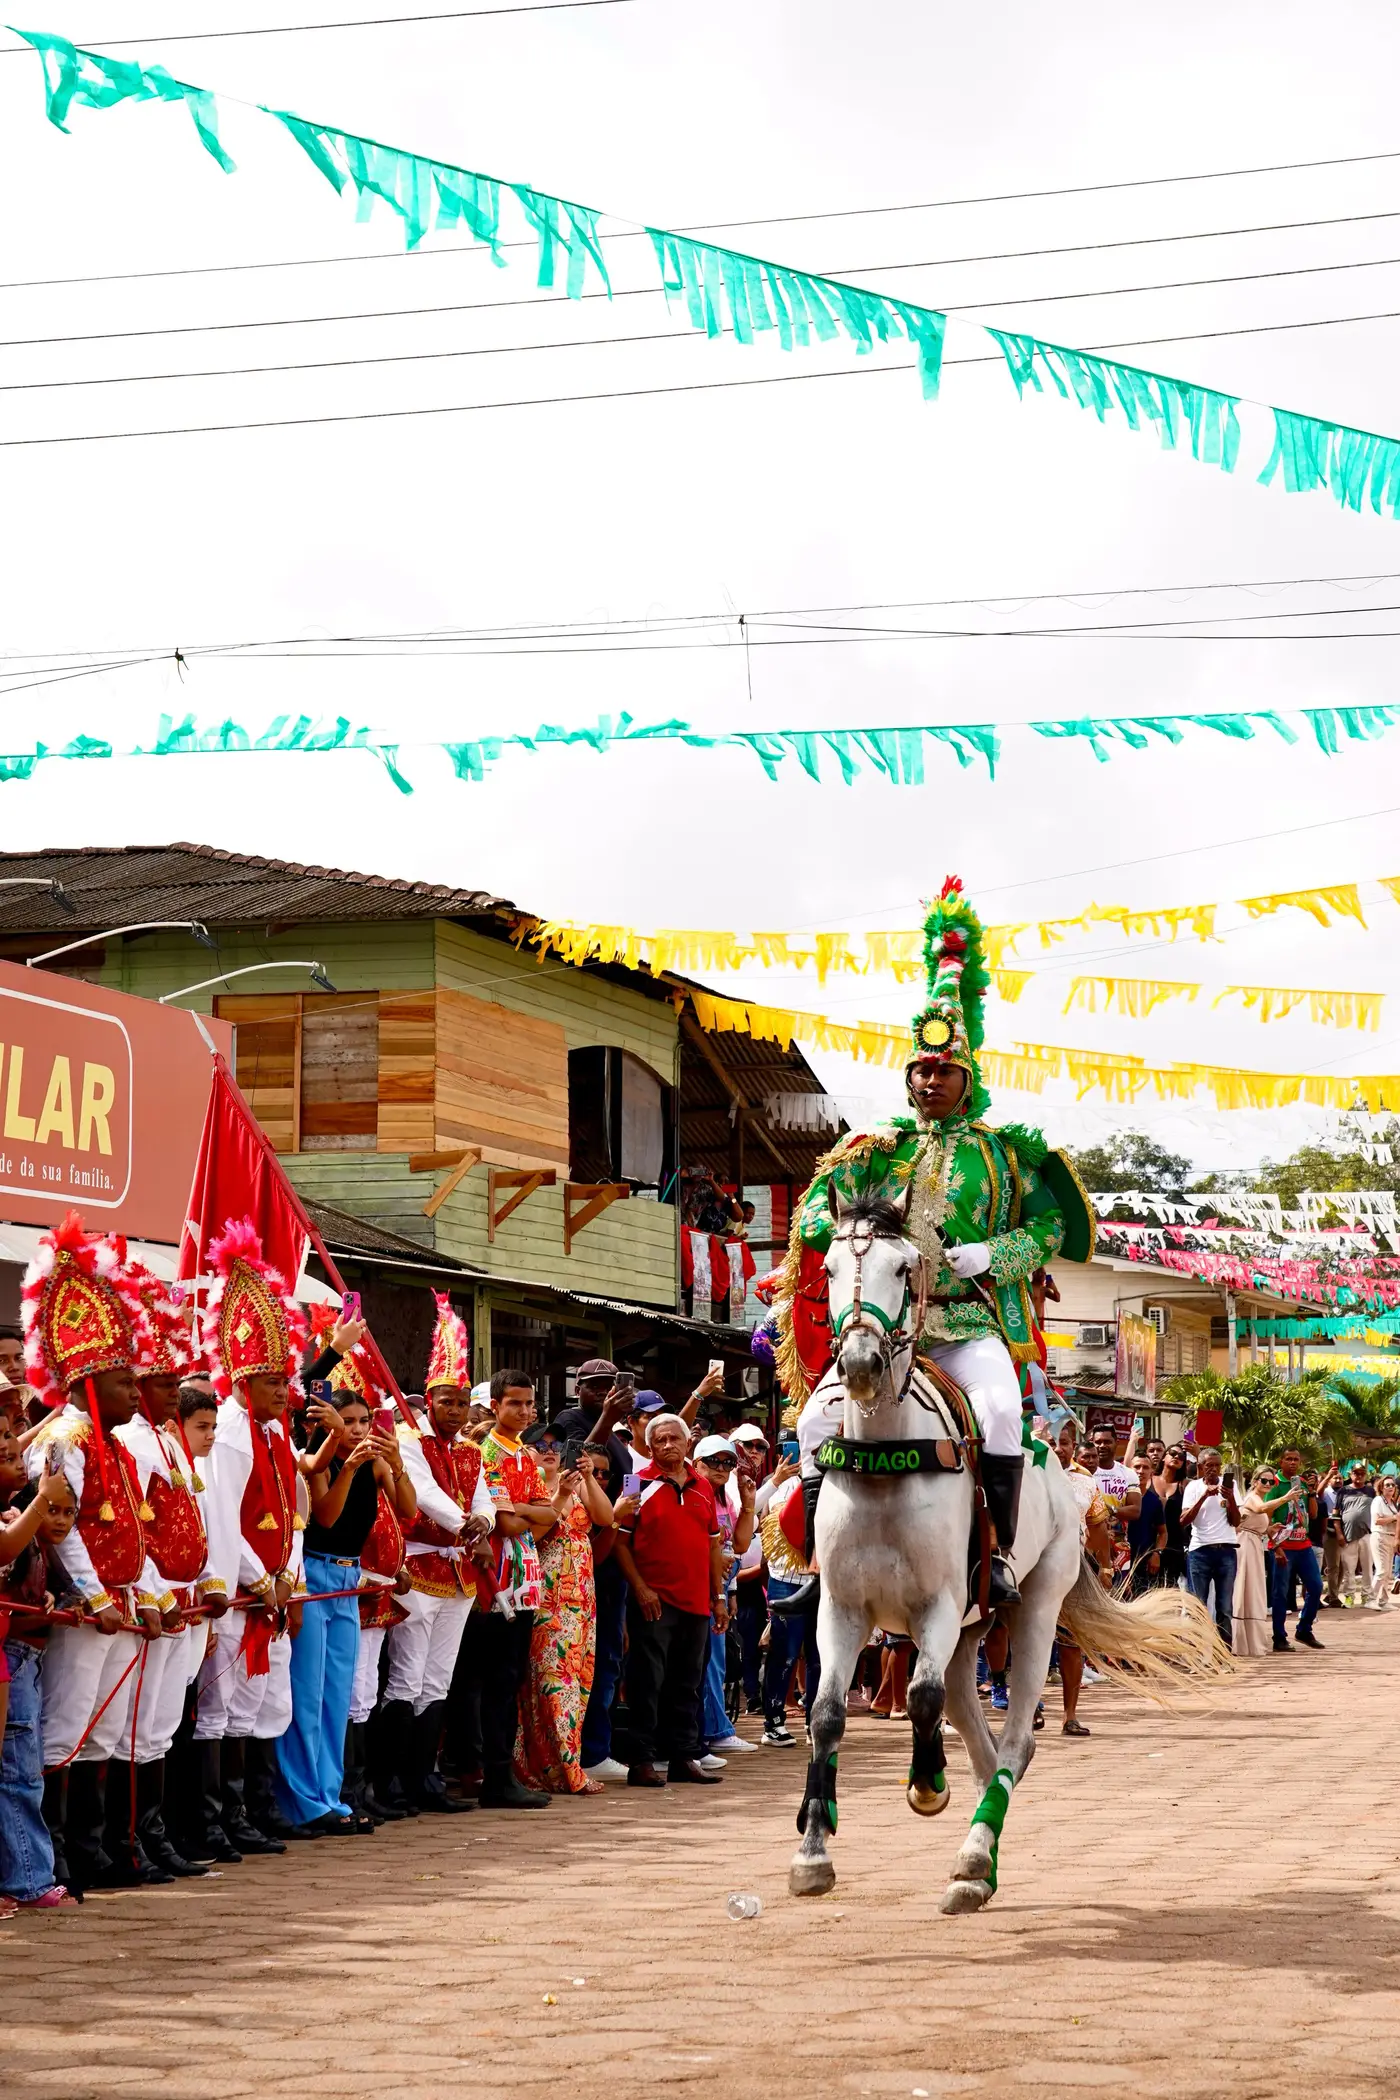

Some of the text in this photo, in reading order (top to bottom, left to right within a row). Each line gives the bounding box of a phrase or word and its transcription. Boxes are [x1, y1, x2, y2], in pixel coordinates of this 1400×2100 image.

[0, 1042, 115, 1156] LAR
[20, 1156, 34, 1177] da
[42, 1164, 62, 1182] sua
[70, 1163, 114, 1190] família.
[854, 1449, 920, 1471] TIAGO
